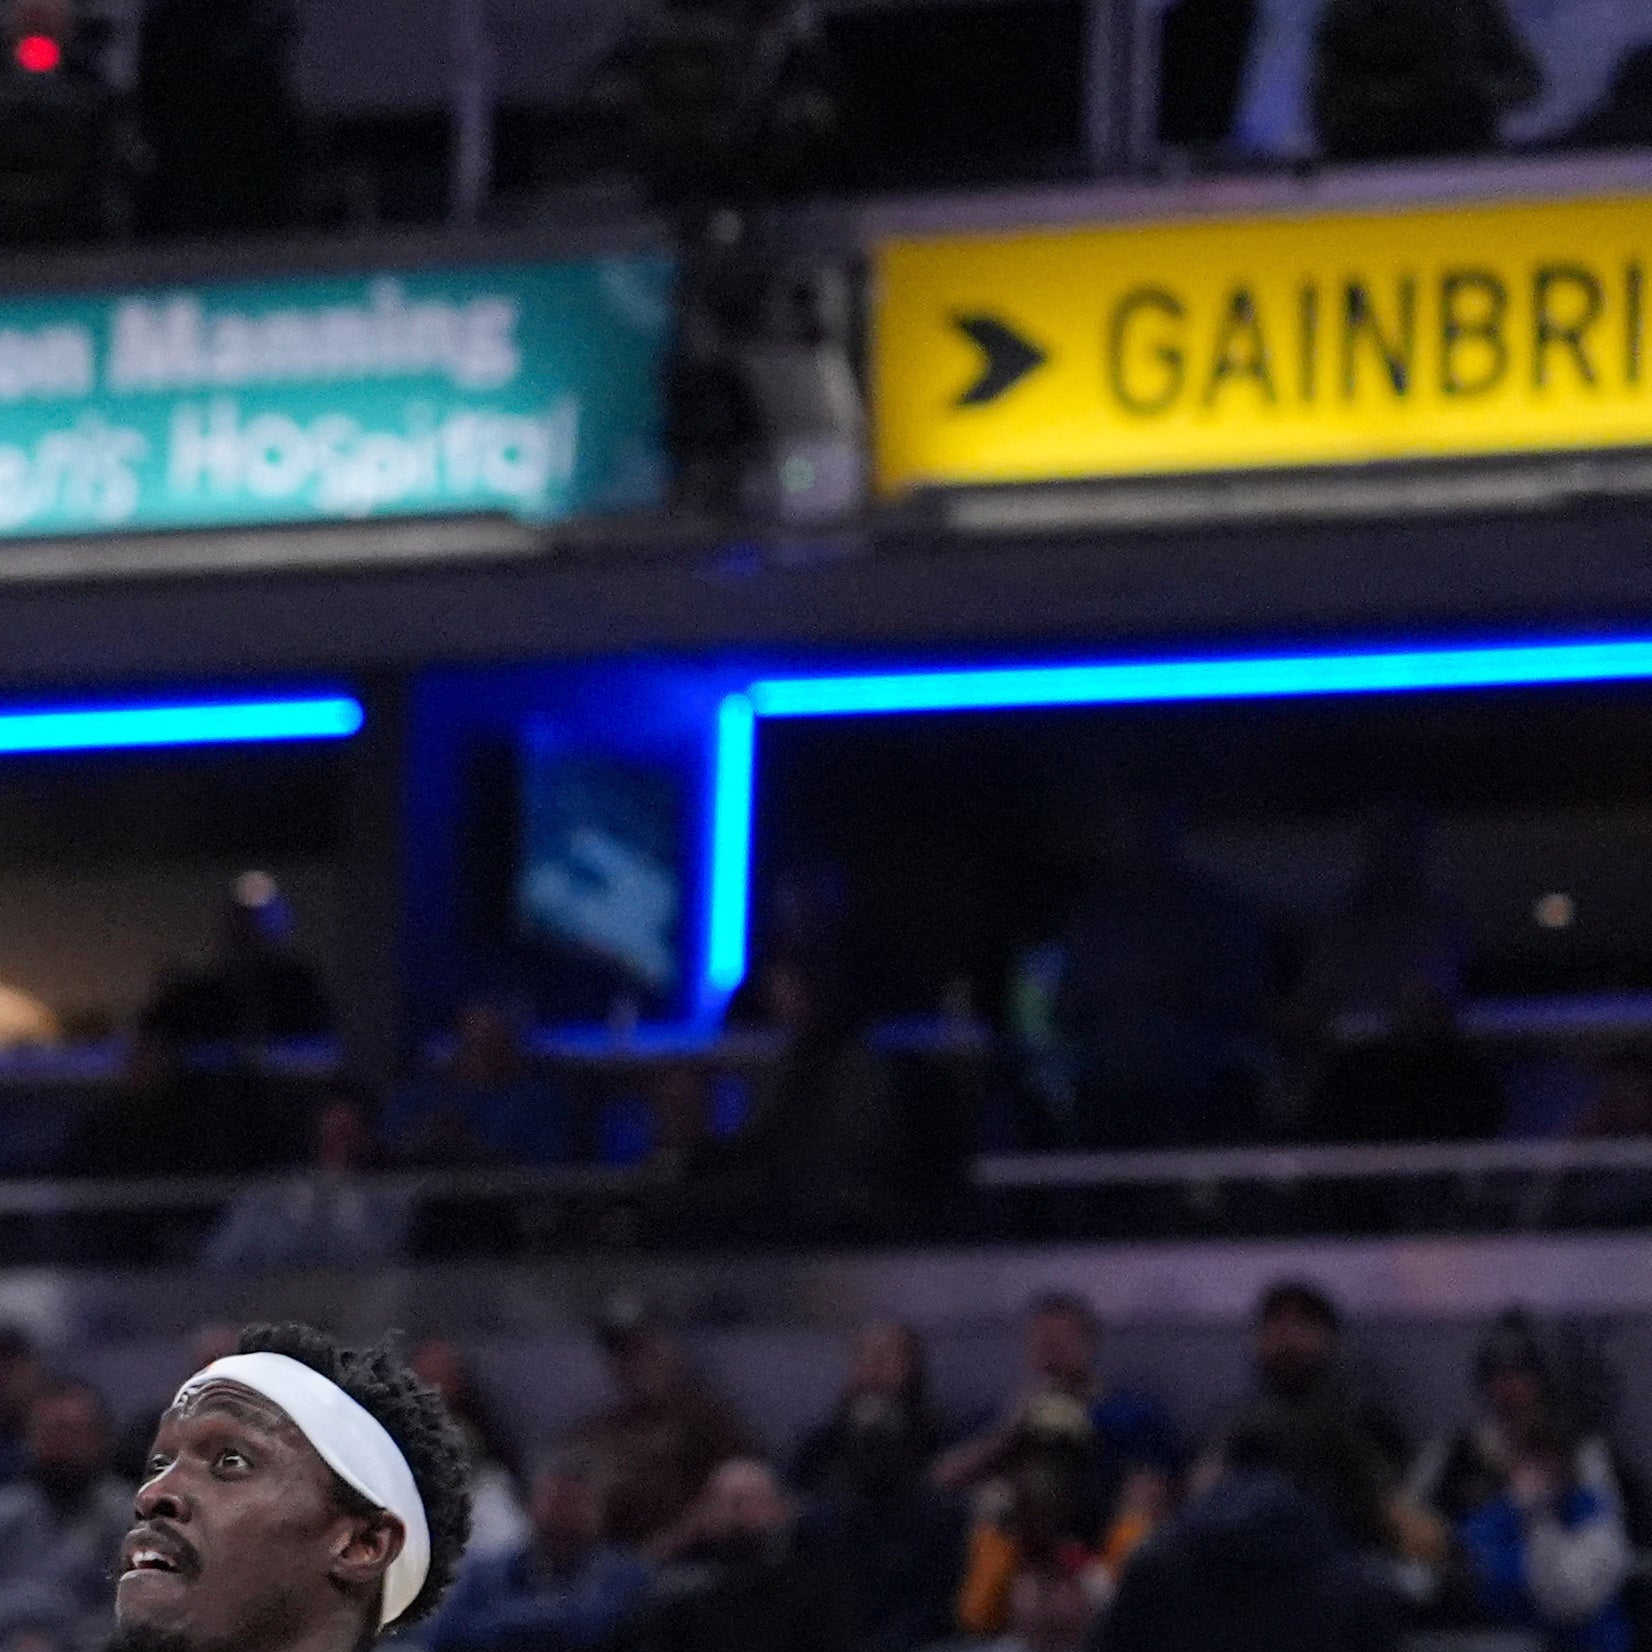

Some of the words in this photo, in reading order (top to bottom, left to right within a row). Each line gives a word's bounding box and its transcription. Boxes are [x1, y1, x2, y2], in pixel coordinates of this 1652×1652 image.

[104, 276, 520, 390] Manning
[1104, 255, 1652, 418] GAINBRI
[164, 397, 581, 520] Hospital
